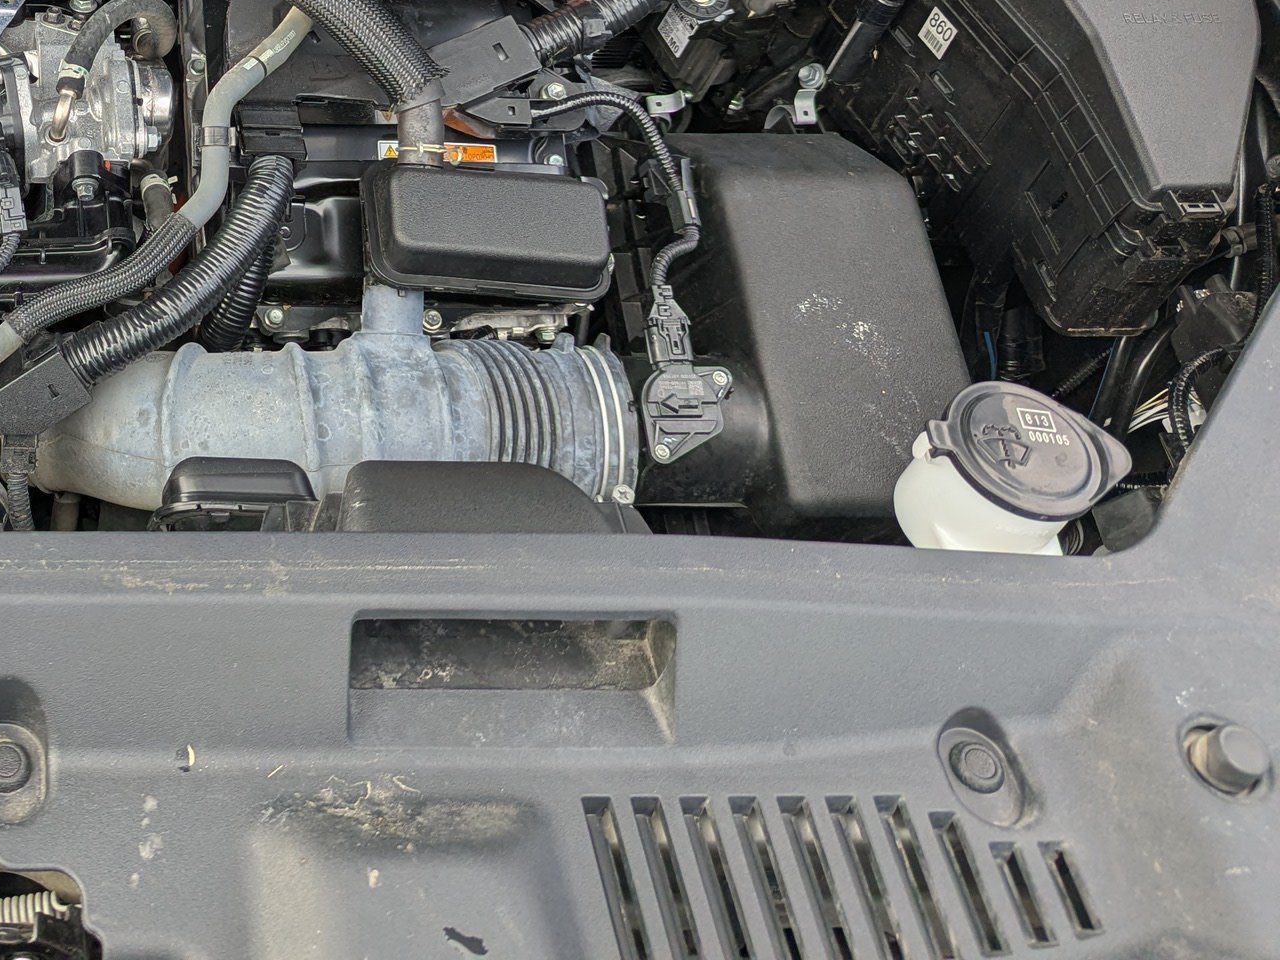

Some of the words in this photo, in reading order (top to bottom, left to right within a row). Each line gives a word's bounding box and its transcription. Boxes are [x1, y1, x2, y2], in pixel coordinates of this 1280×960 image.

[1183, 12, 1222, 24] FUSE
[930, 13, 952, 41] 860
[1029, 431, 1070, 446] 000105
